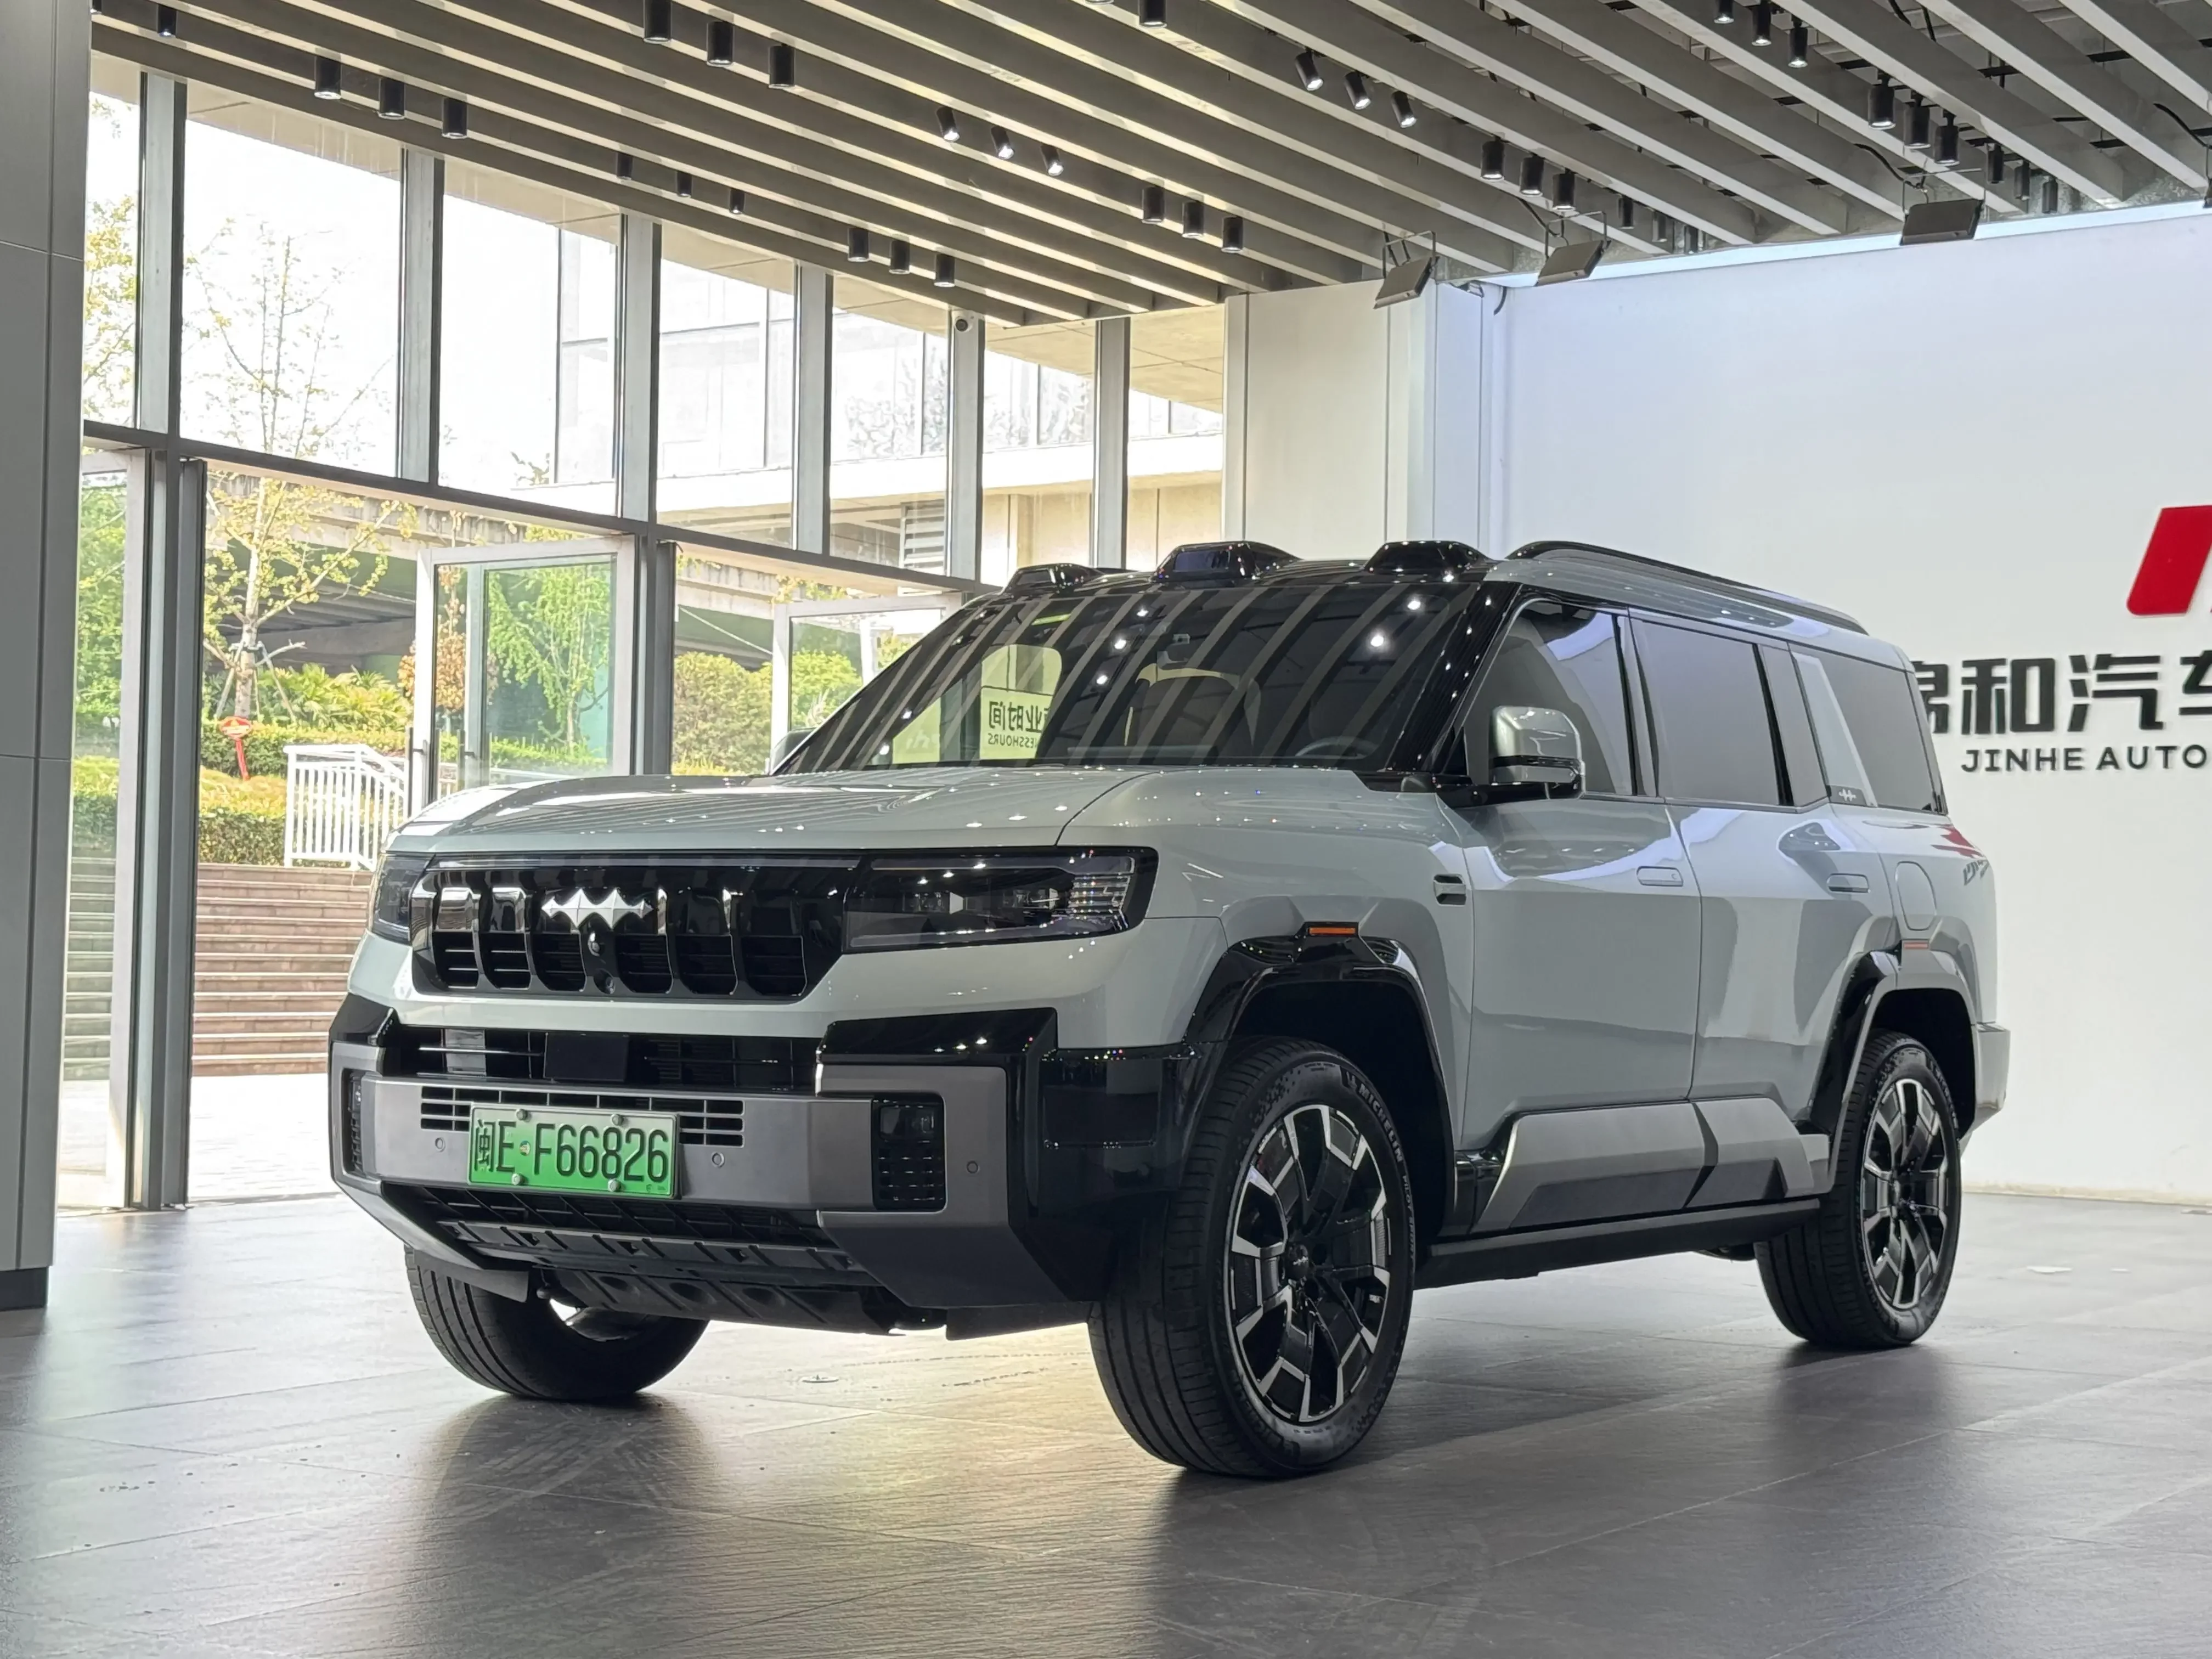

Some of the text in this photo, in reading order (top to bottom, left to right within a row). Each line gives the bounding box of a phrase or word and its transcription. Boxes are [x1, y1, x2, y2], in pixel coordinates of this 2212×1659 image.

[1961, 744, 2207, 772] JINHE AUTO
[1359, 1083, 1403, 1163] MICHELIN
